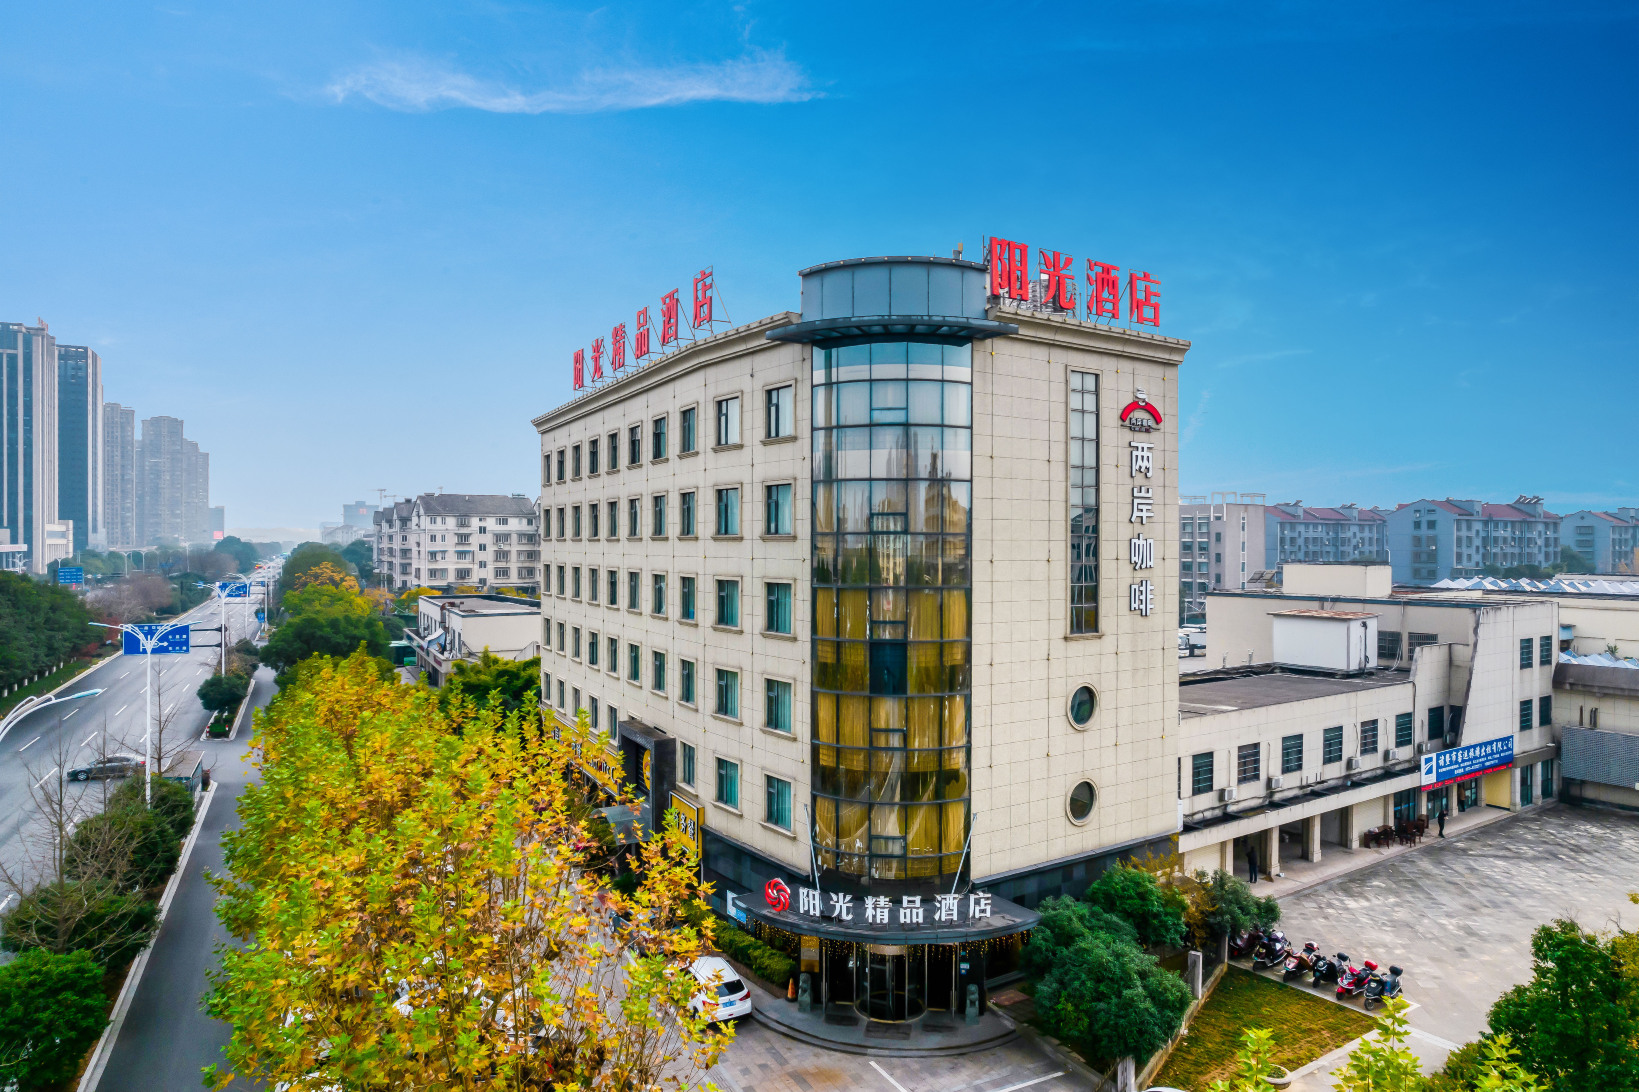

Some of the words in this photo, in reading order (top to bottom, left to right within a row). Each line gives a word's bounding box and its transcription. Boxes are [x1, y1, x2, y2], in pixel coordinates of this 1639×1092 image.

[573, 270, 713, 390] 阳光精品酒店
[990, 236, 1161, 327] 阳光酒店
[1130, 441, 1155, 617] 两岸咖啡
[799, 887, 992, 924] 阳光精品酒店
